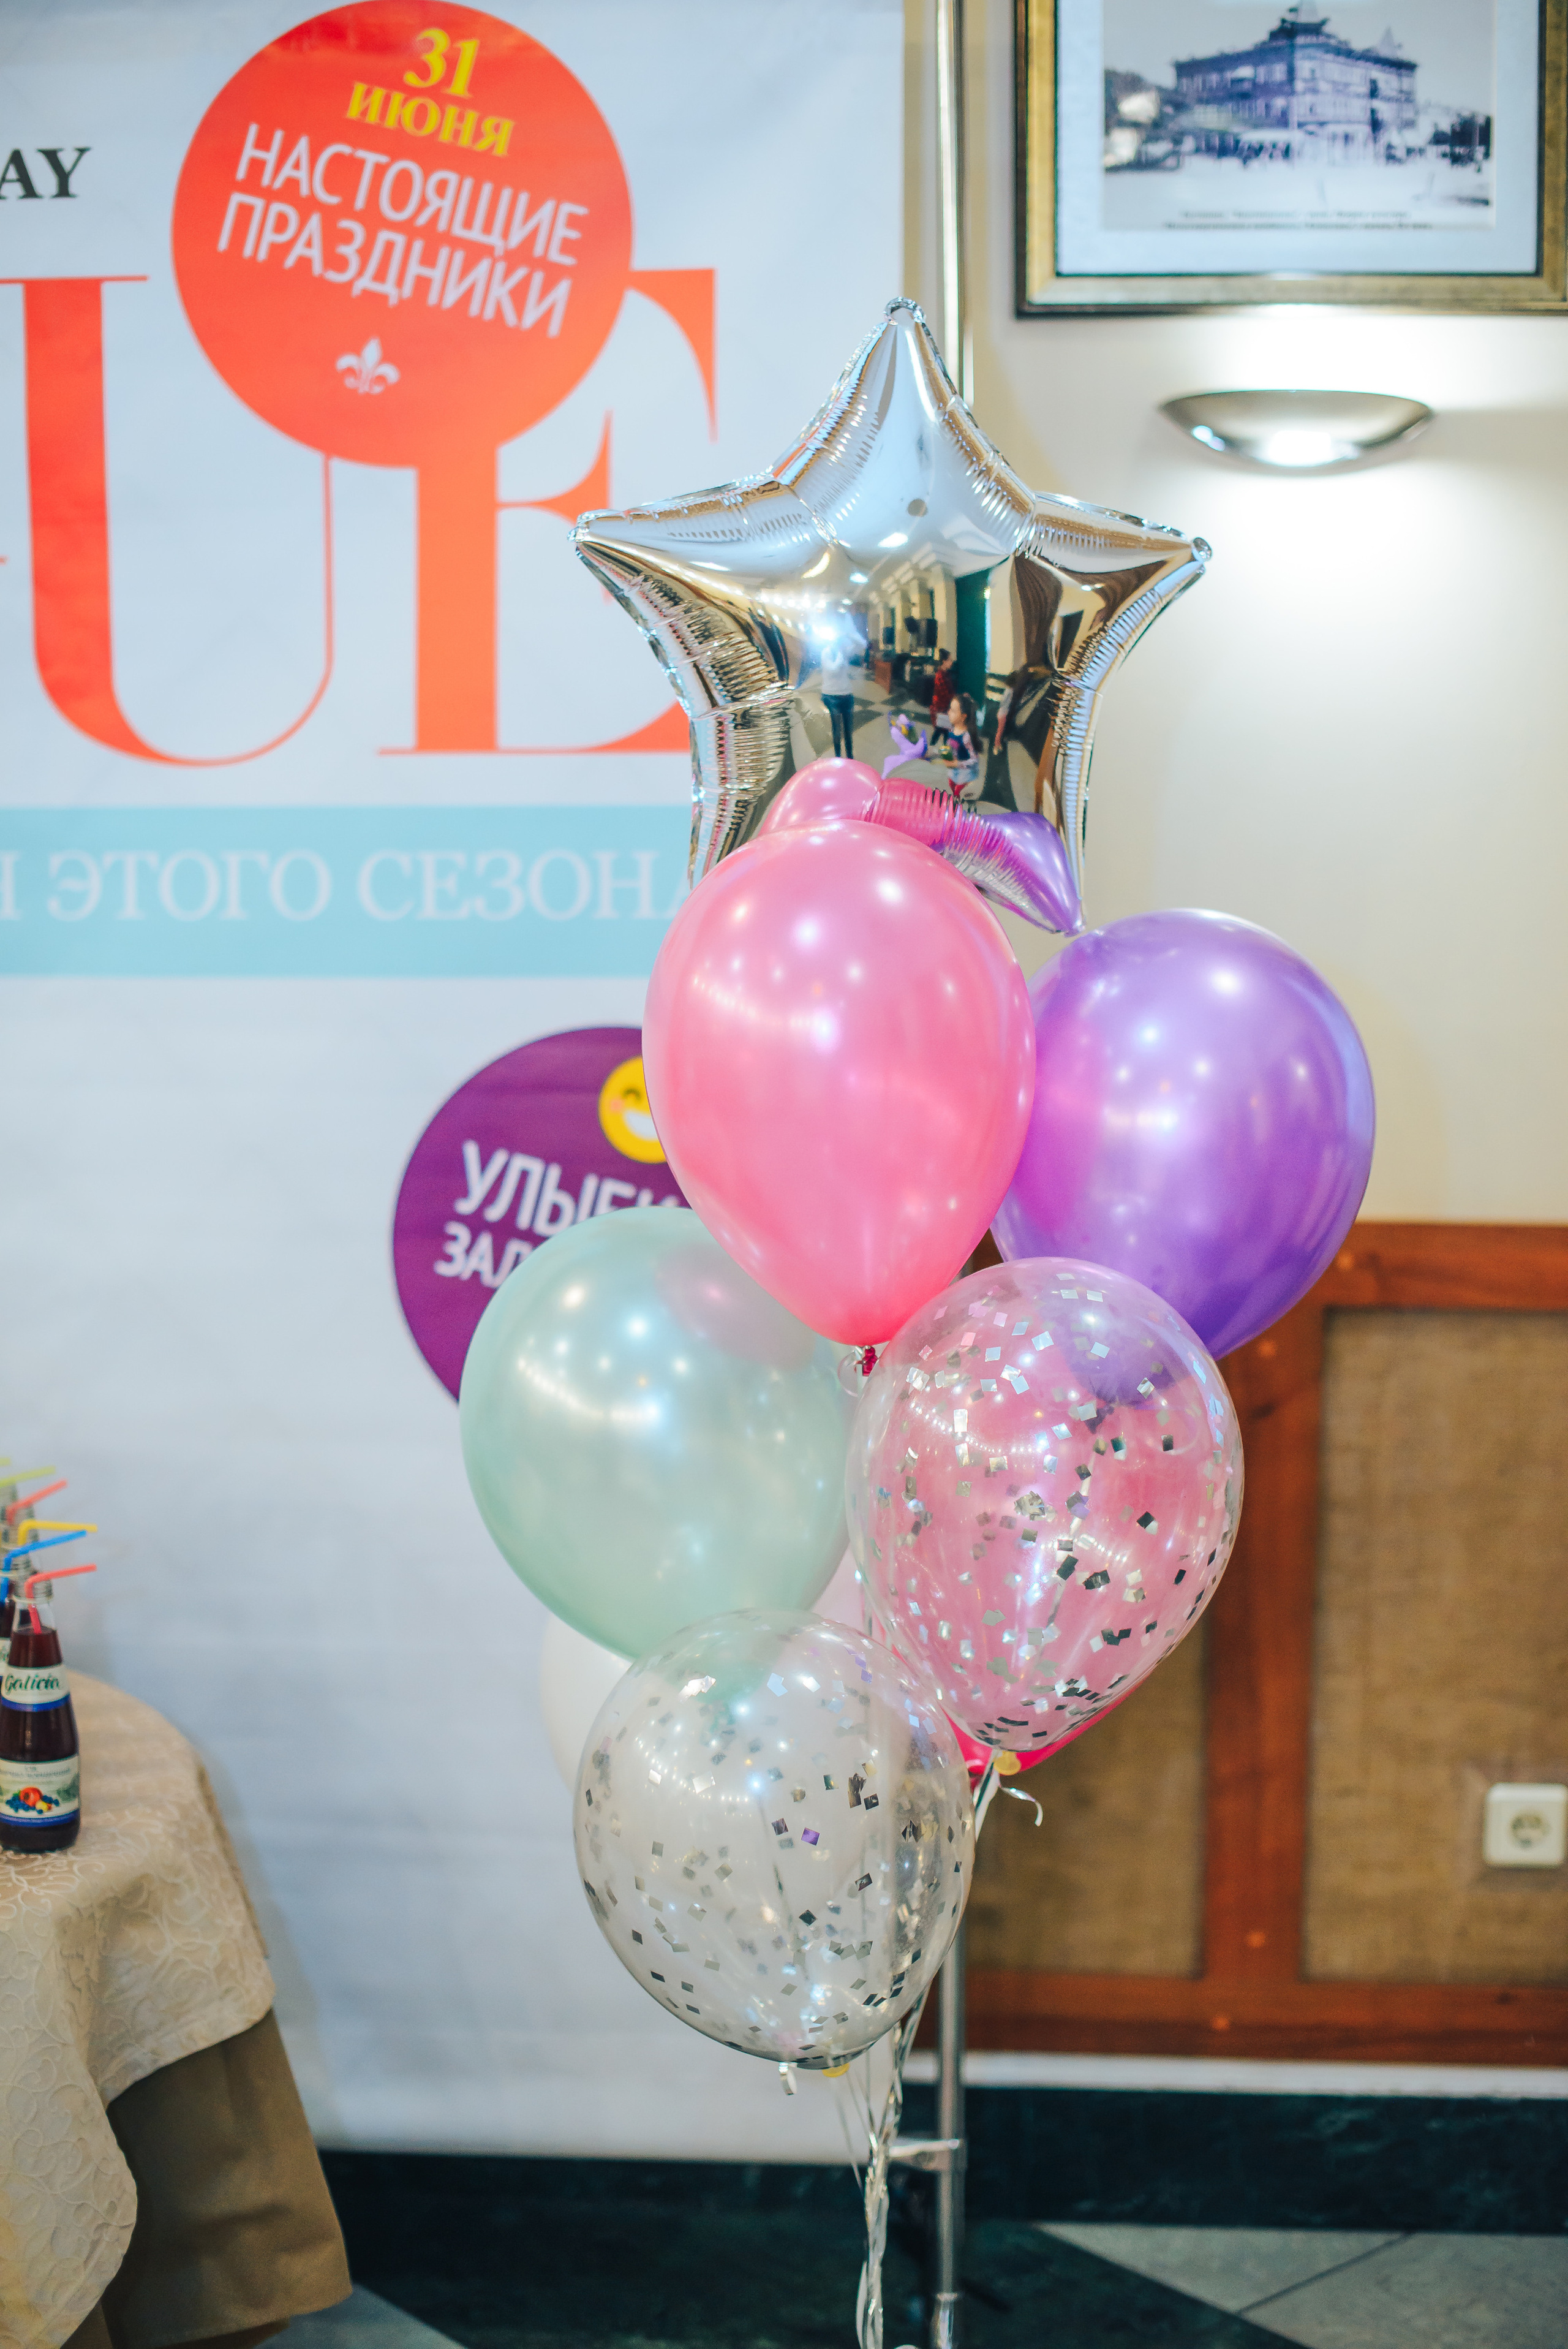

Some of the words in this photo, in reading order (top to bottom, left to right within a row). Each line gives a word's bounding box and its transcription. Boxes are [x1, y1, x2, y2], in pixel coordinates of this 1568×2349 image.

[403, 28, 480, 98] 31
[0, 146, 92, 200] AY
[235, 123, 589, 266] НАСТОЯЩИЕ
[217, 191, 572, 338] ПРАЗДНИКИ
[47, 849, 333, 921] ЭТОГО
[5, 1673, 60, 1695] Galicia
